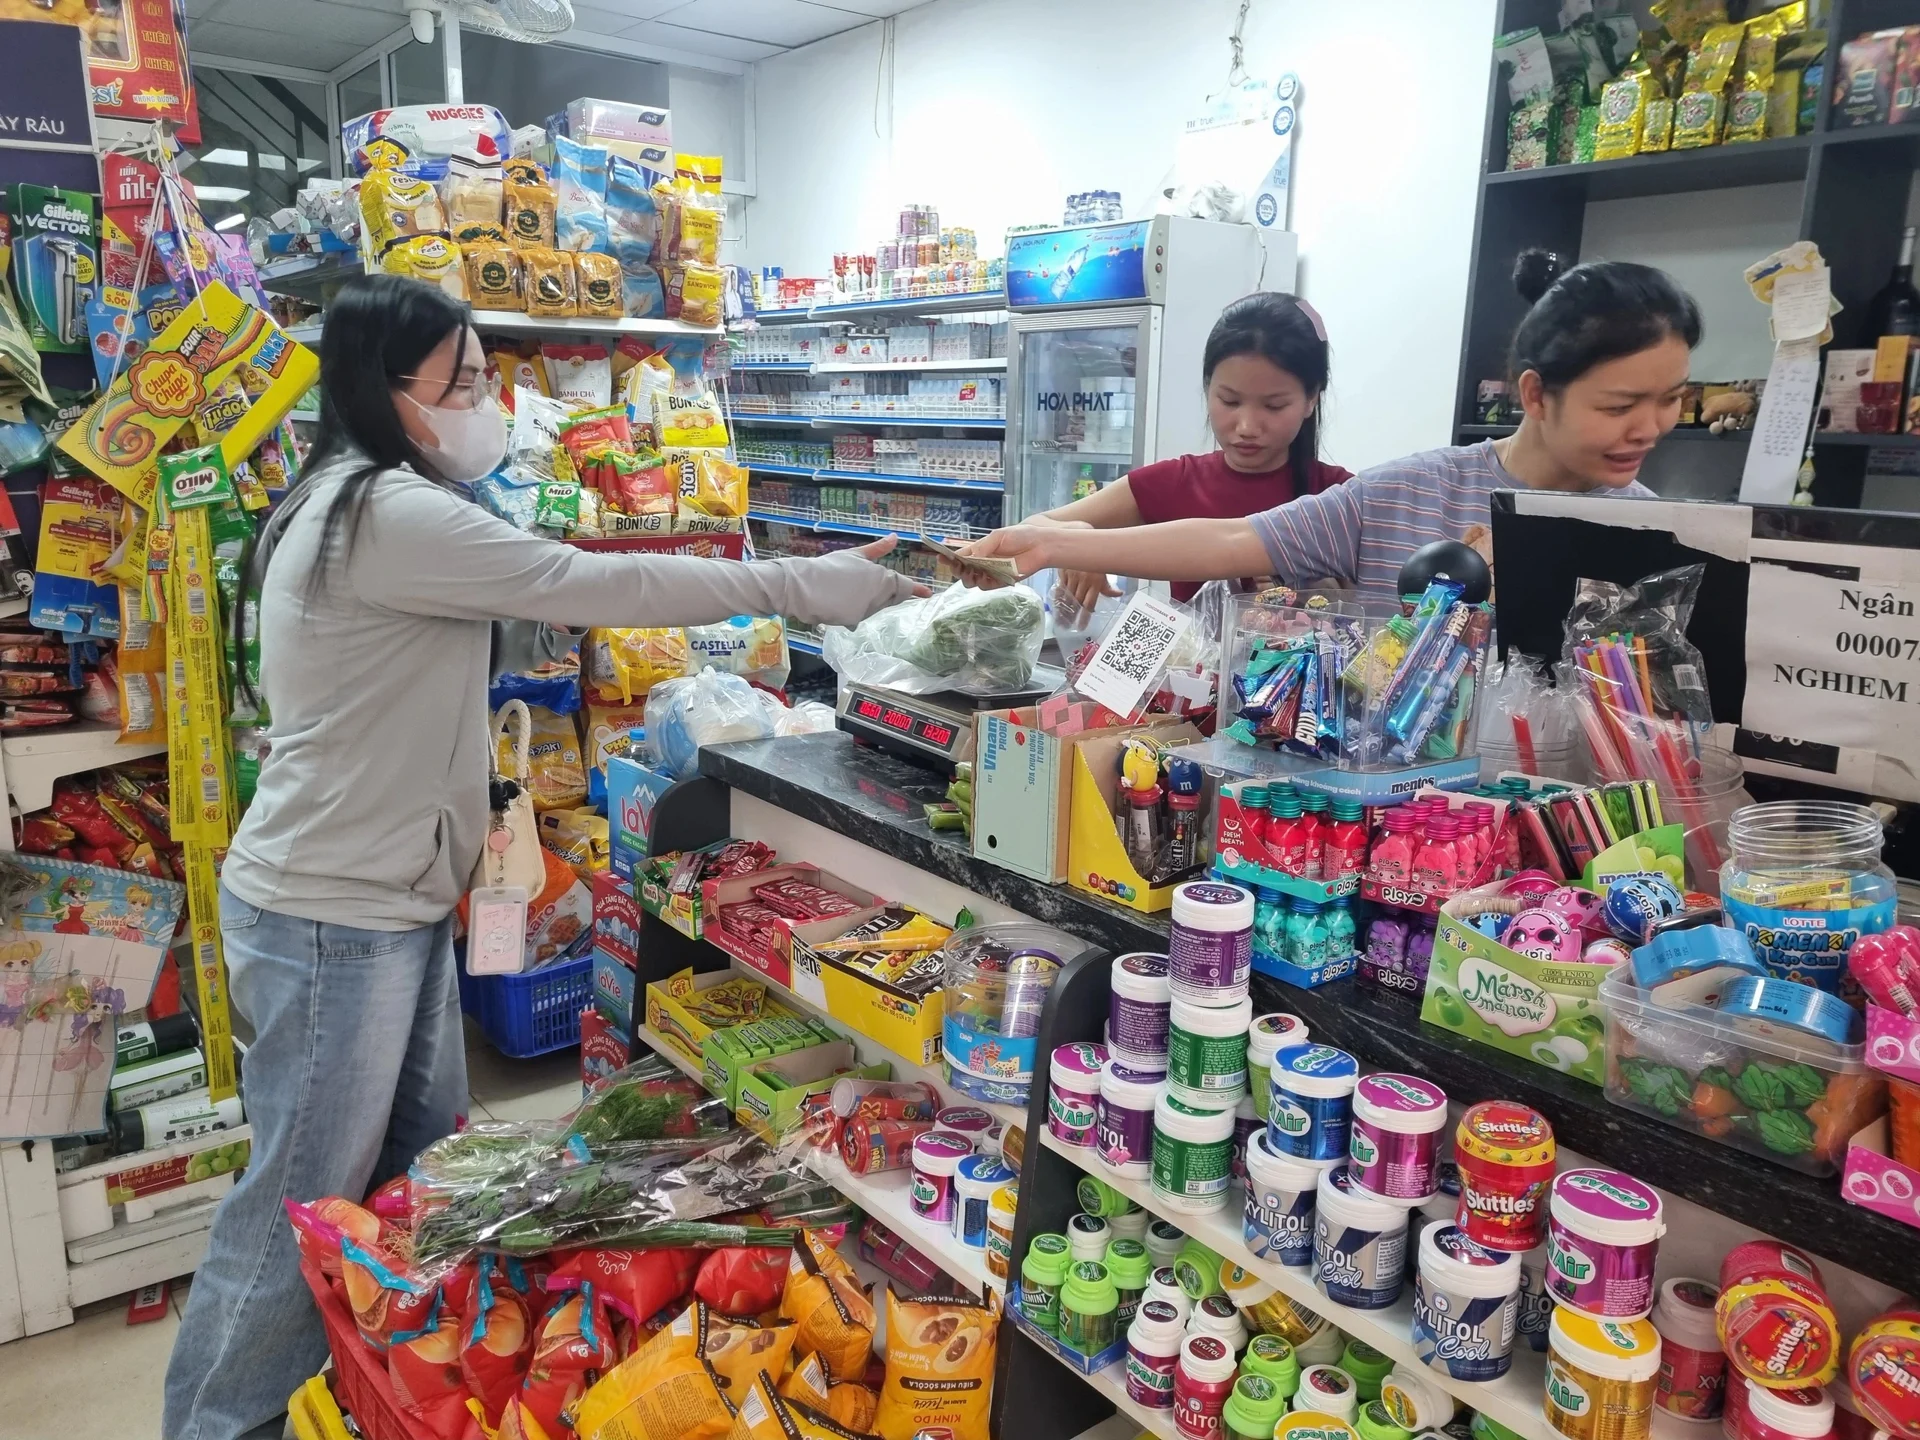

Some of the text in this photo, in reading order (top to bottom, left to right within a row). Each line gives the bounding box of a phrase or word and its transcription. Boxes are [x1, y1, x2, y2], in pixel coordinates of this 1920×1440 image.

[26, 116, 65, 135] RÂU
[425, 106, 486, 122] HUGGIES
[43, 203, 90, 222] Gillette
[25, 212, 92, 237] VECTOR
[178, 328, 203, 358] SOUR
[145, 363, 178, 396] Chupa
[155, 373, 191, 406] Chups
[61, 485, 95, 500] Gillette
[175, 471, 214, 491] MILO
[547, 487, 574, 496] MILO
[616, 516, 643, 531] BON!
[1838, 589, 1914, 619] Ngân
[691, 639, 747, 651] CASTELLA
[1836, 631, 1920, 662] 00007
[1773, 662, 1909, 703] NGHIEM
[1390, 774, 1435, 796] mentos
[1220, 837, 1245, 846] BREATH
[1223, 830, 1241, 839] FRESH
[1783, 917, 1827, 929] LOTTE
[1747, 924, 1858, 953] DORAEMON
[597, 969, 622, 999] laVie
[1463, 968, 1547, 1009] Marsh
[1477, 995, 1546, 1024] mallow
[1064, 1107, 1094, 1127] Air
[1276, 1112, 1307, 1133] Air
[1478, 1121, 1541, 1136] Skittles
[1351, 1143, 1375, 1163] Air
[914, 1181, 936, 1202] Air
[1466, 1187, 1536, 1214] Skittles
[1244, 1200, 1310, 1231] XYLITOL
[1268, 1228, 1314, 1250] Cool
[1319, 1261, 1363, 1289] Cool
[1555, 1253, 1591, 1280] Air
[1412, 1297, 1485, 1344] XYLITOL
[1194, 1339, 1221, 1359] XYLITOL
[1435, 1336, 1491, 1361] Cool
[1765, 1318, 1812, 1376] Skittles
[1127, 1351, 1158, 1389] Cool
[1549, 1380, 1586, 1412] Air
[933, 1413, 962, 1425] KINH
